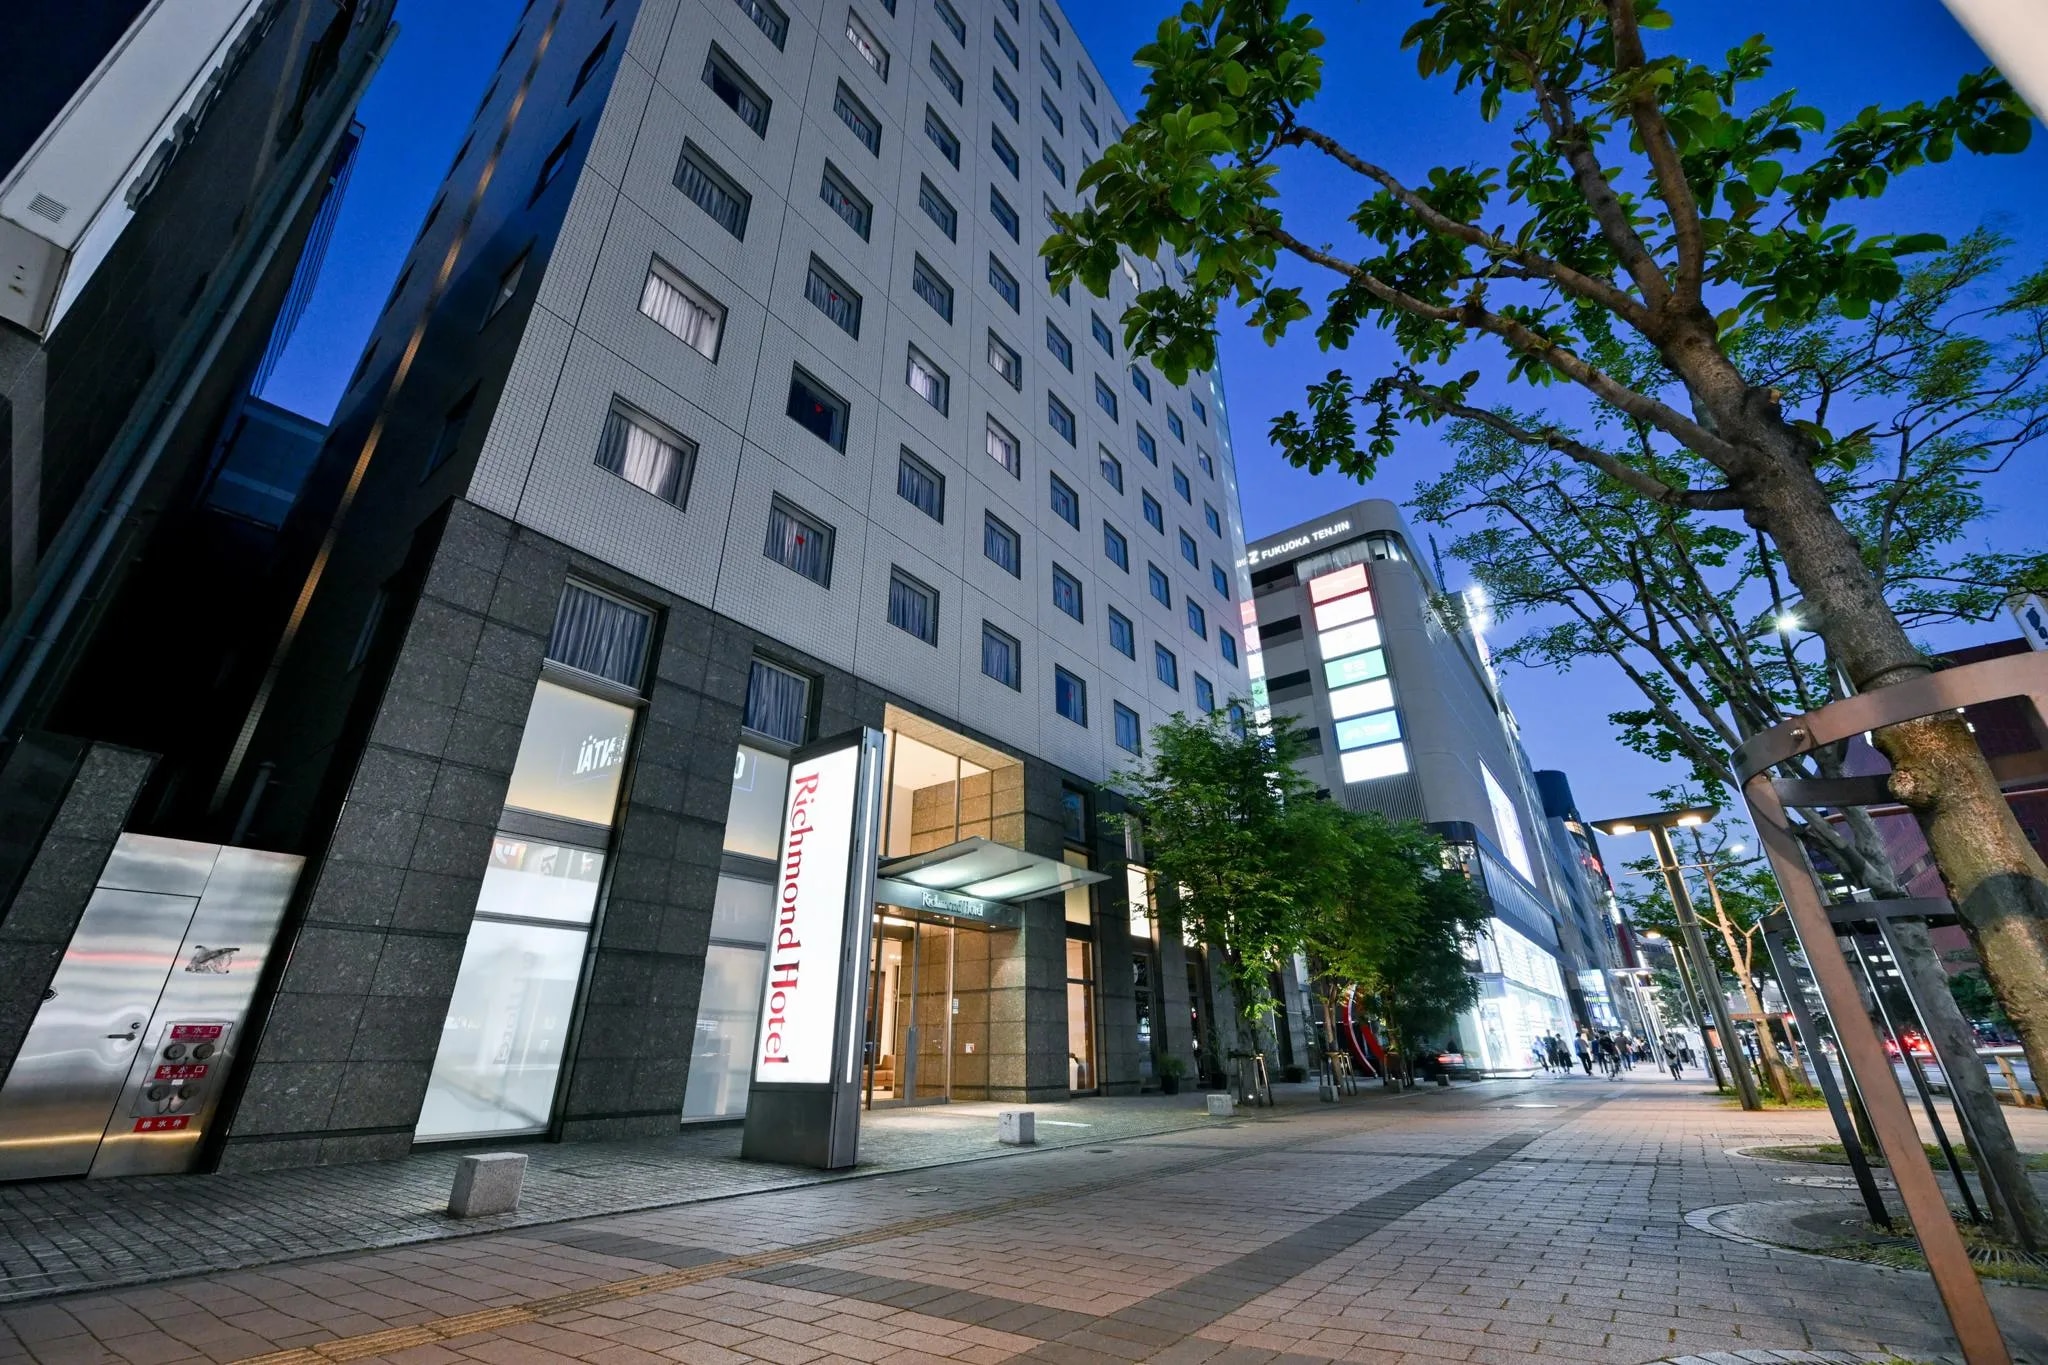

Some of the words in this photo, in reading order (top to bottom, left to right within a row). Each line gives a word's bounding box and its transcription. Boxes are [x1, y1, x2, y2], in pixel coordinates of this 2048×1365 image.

[1261, 536, 1310, 560] FUKUOKA
[1312, 521, 1350, 541] TENJIN
[777, 772, 820, 954] Richmond
[763, 960, 800, 1065] Hotel
[161, 1066, 204, 1074] 送水口
